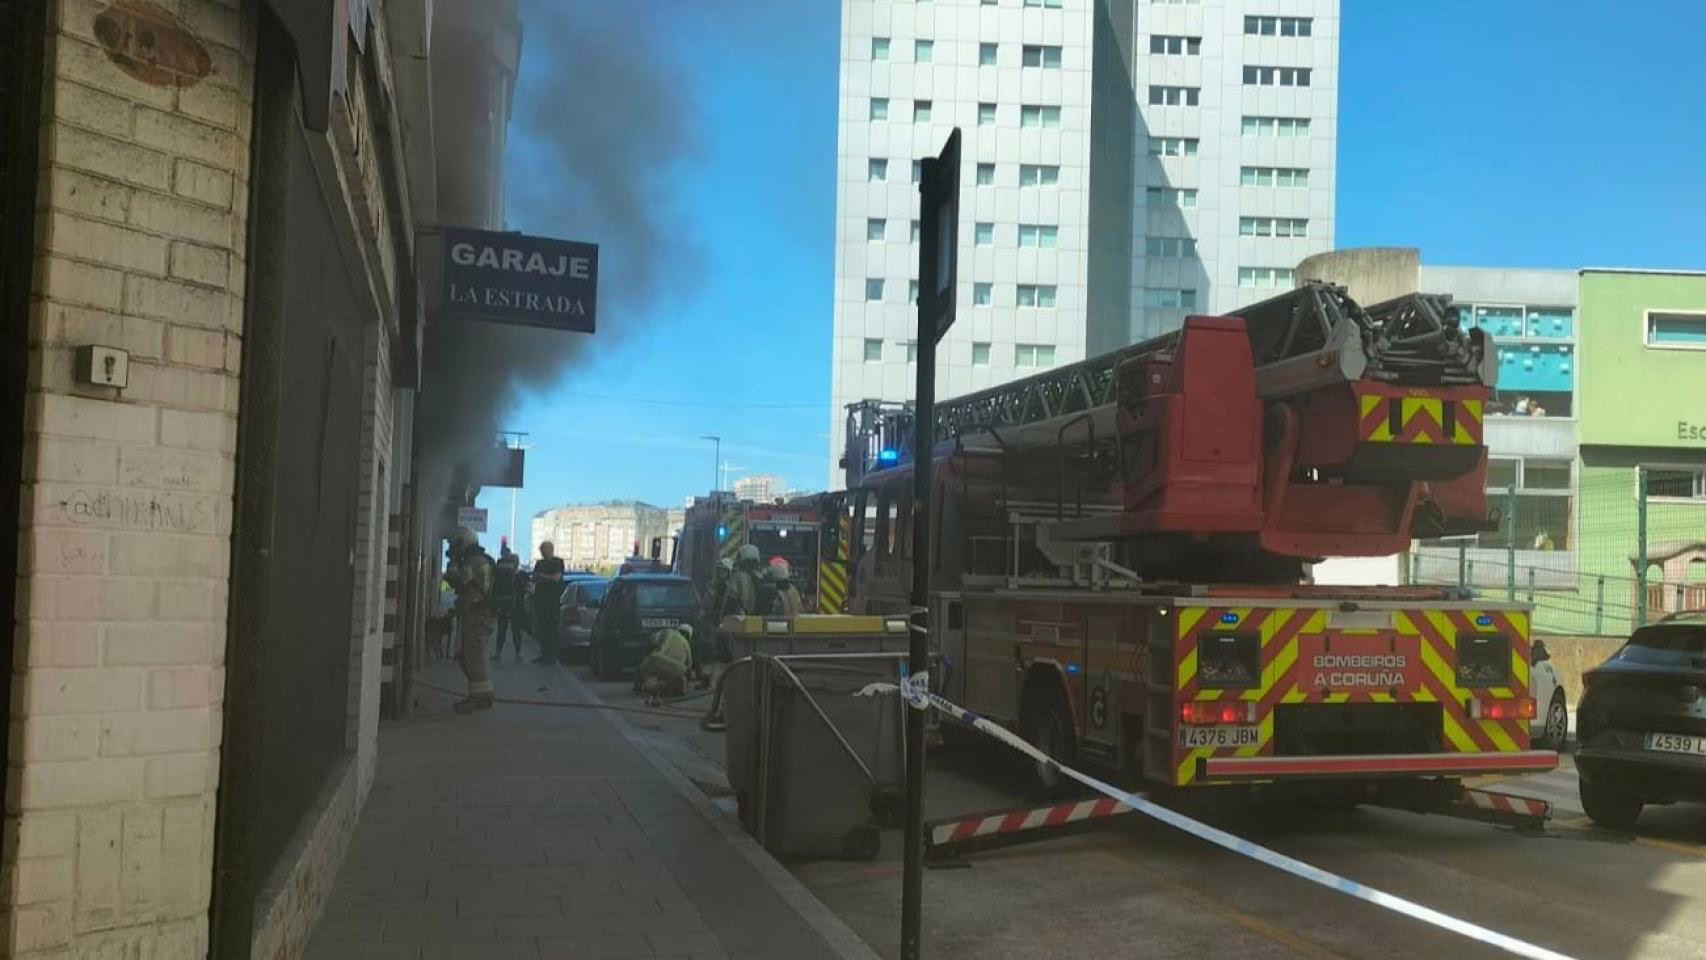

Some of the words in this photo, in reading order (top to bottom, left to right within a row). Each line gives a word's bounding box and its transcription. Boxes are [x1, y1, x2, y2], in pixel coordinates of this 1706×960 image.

[451, 243, 590, 279] GARAJE
[450, 283, 478, 303] LA
[485, 287, 586, 315] ESTRADA
[1313, 655, 1406, 668] BOMBEIROS
[1314, 672, 1328, 686] A
[1330, 669, 1405, 686] CORUÑA
[1189, 729, 1226, 745] 4376
[1232, 727, 1259, 744] JBM
[1655, 736, 1691, 751] 4539
